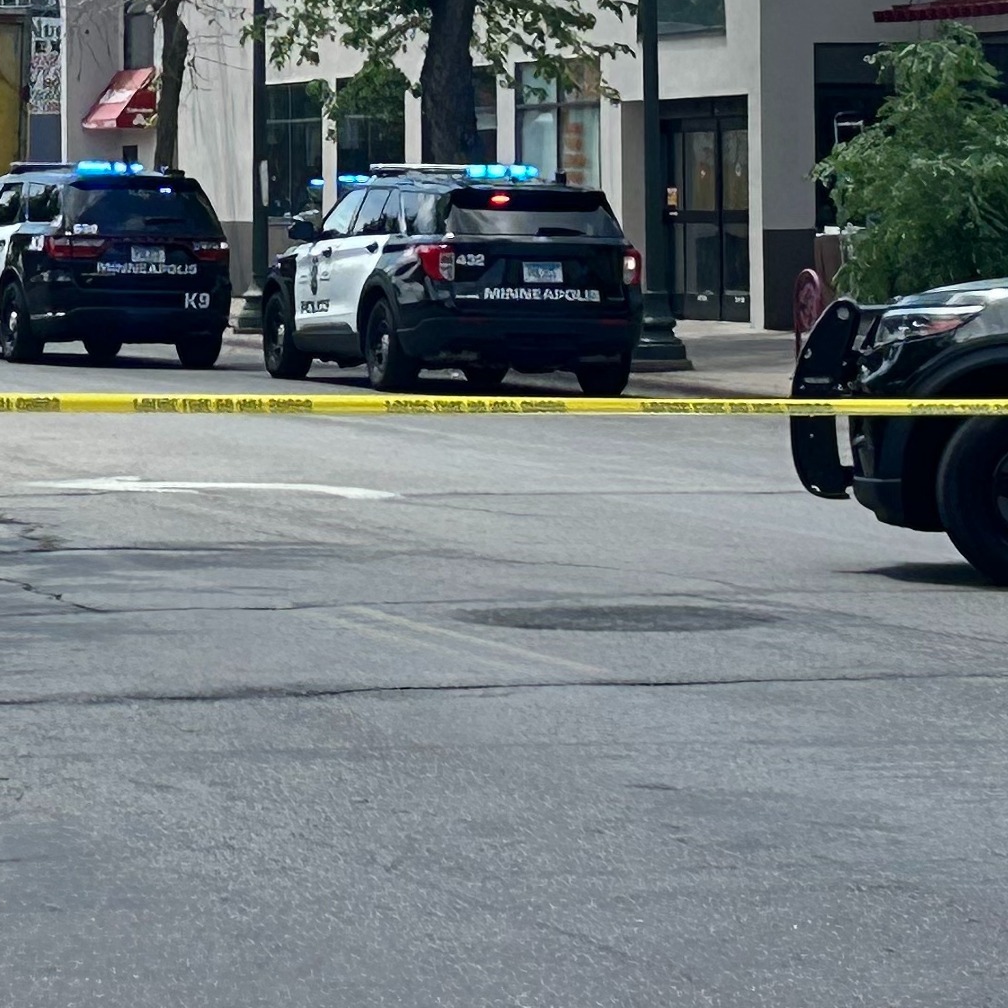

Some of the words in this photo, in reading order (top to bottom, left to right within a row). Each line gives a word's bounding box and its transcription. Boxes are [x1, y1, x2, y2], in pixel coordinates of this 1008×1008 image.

[455, 253, 486, 267] 432
[96, 261, 198, 275] MINNEAPOLIS
[184, 292, 211, 309] K9
